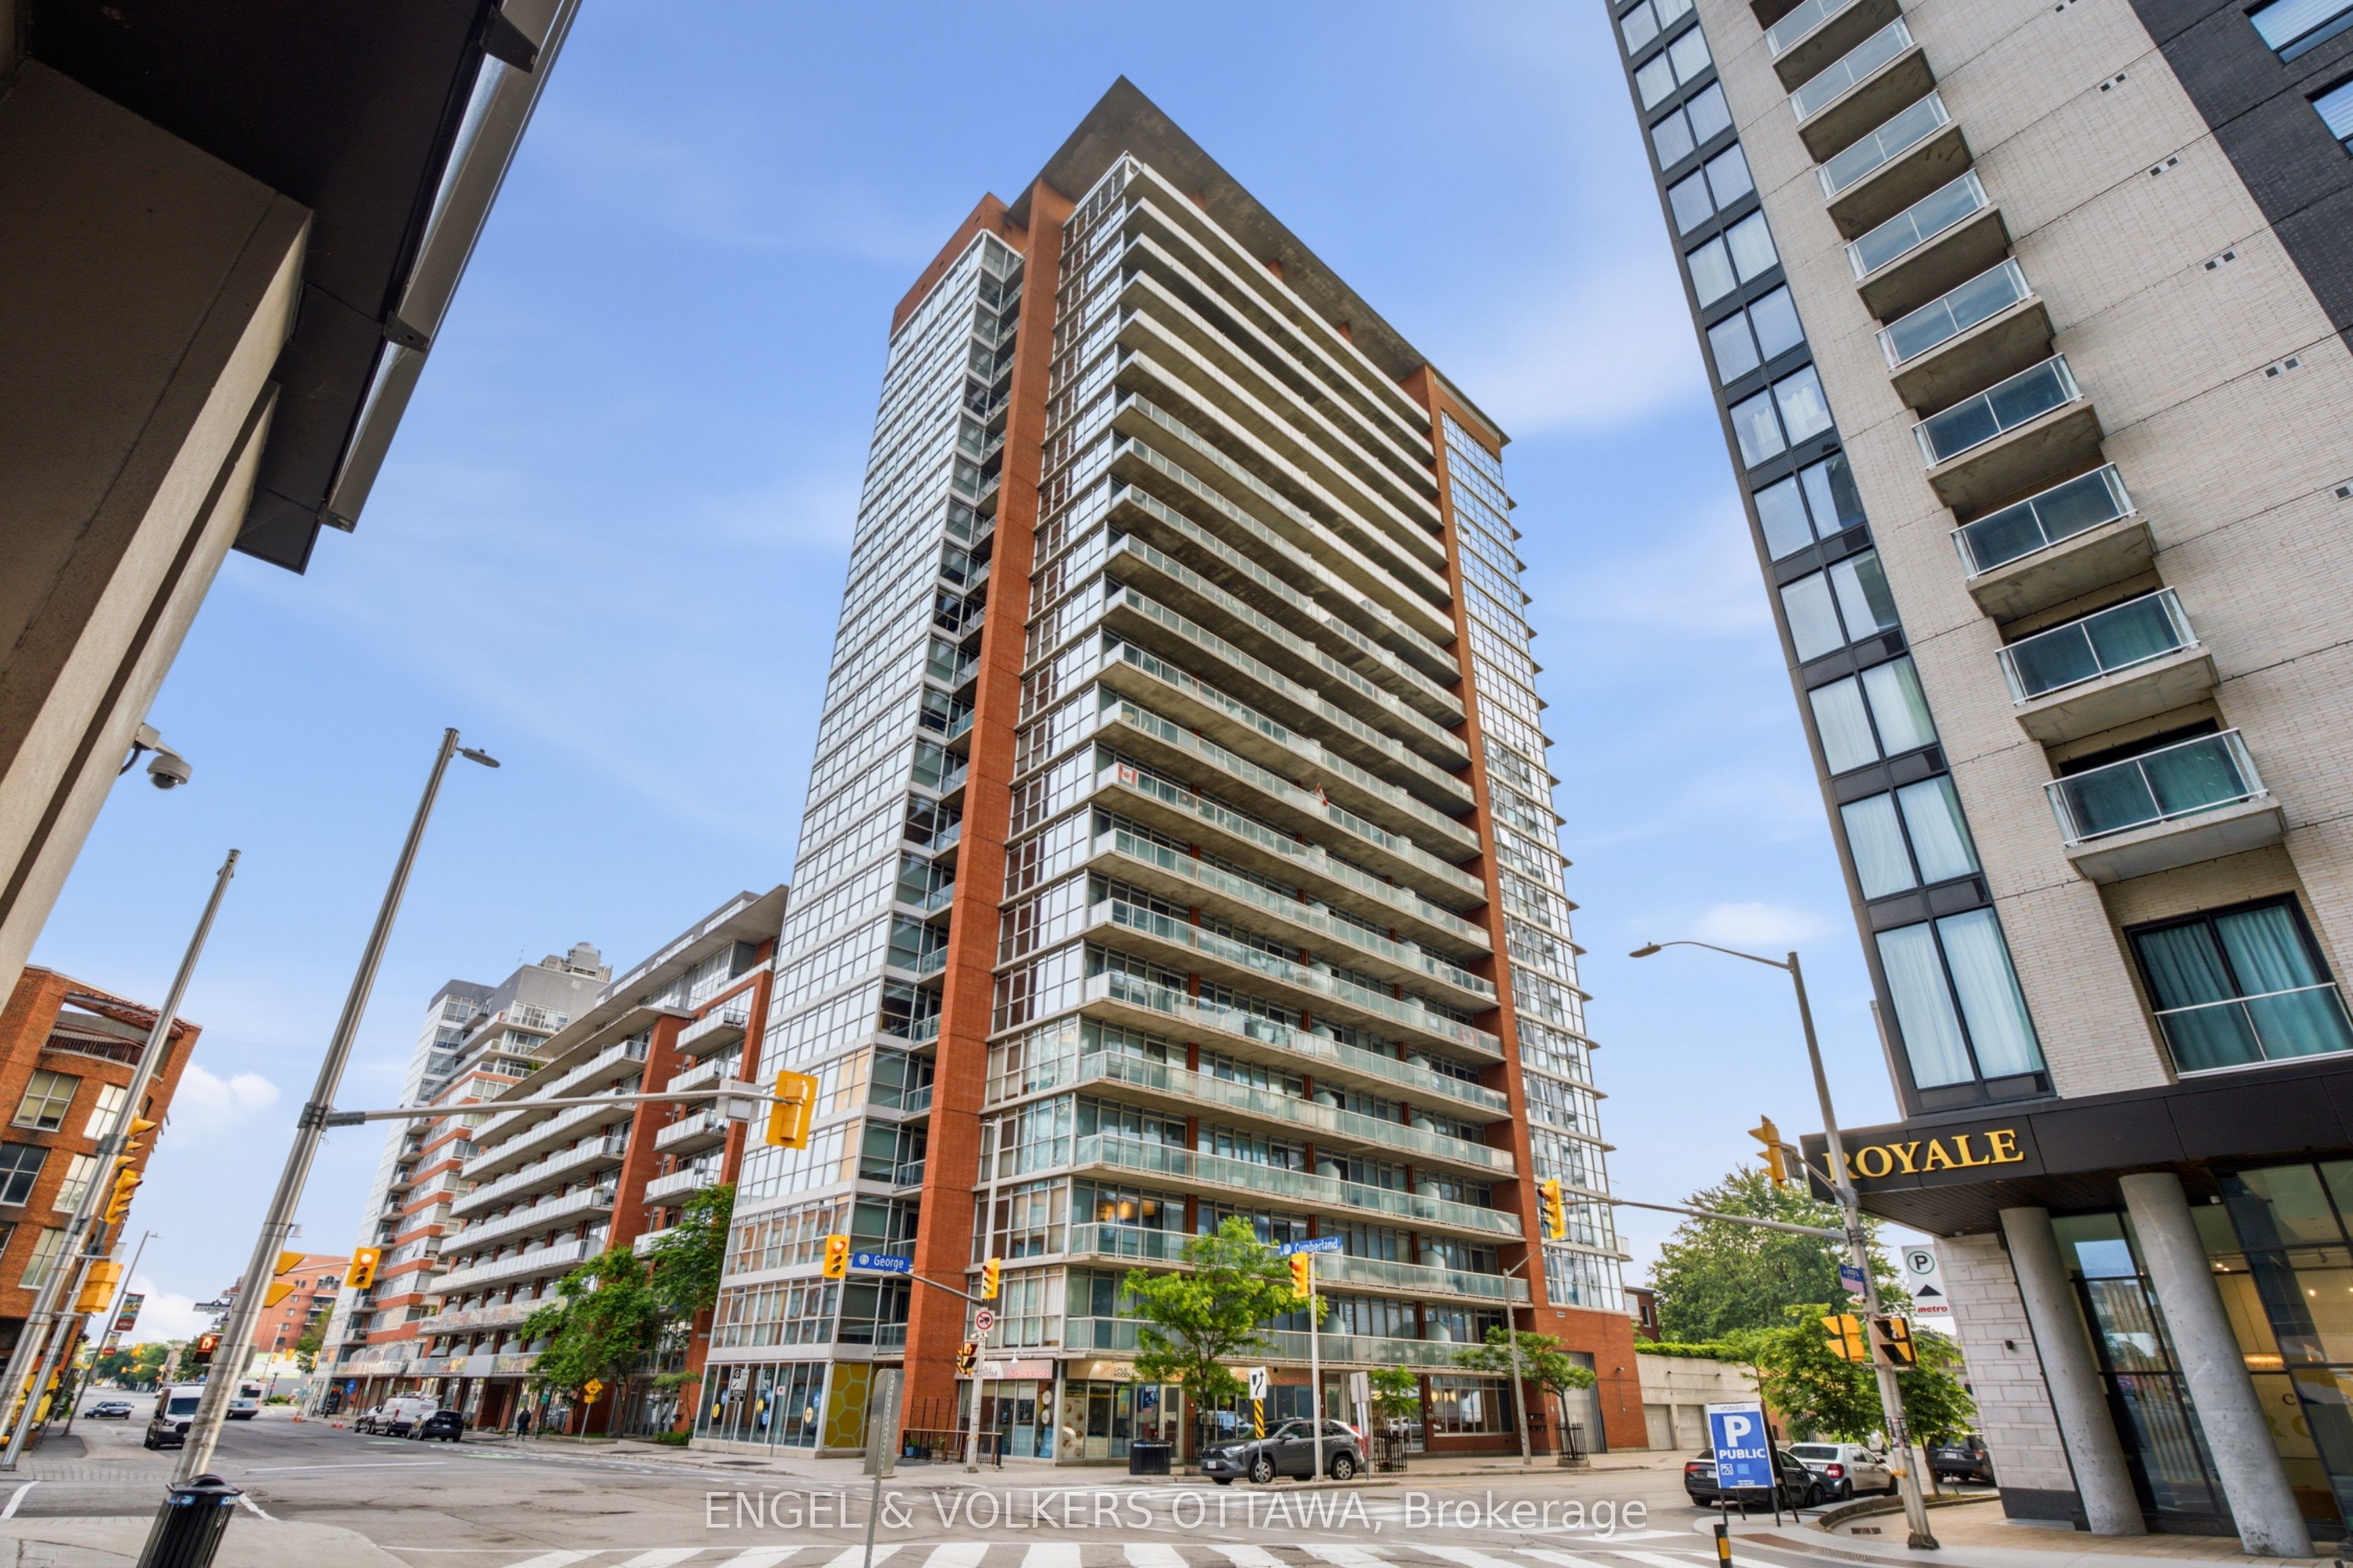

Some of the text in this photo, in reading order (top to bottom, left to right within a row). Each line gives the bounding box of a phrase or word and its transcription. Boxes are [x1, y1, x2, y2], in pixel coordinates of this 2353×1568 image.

[1822, 1129, 2025, 1182] ROYALE
[1295, 1238, 1338, 1252] Cumberland
[874, 1255, 904, 1270] George
[1914, 1256, 1928, 1270] P
[1723, 1415, 1751, 1448] P
[1719, 1449, 1766, 1460] PUBLIC
